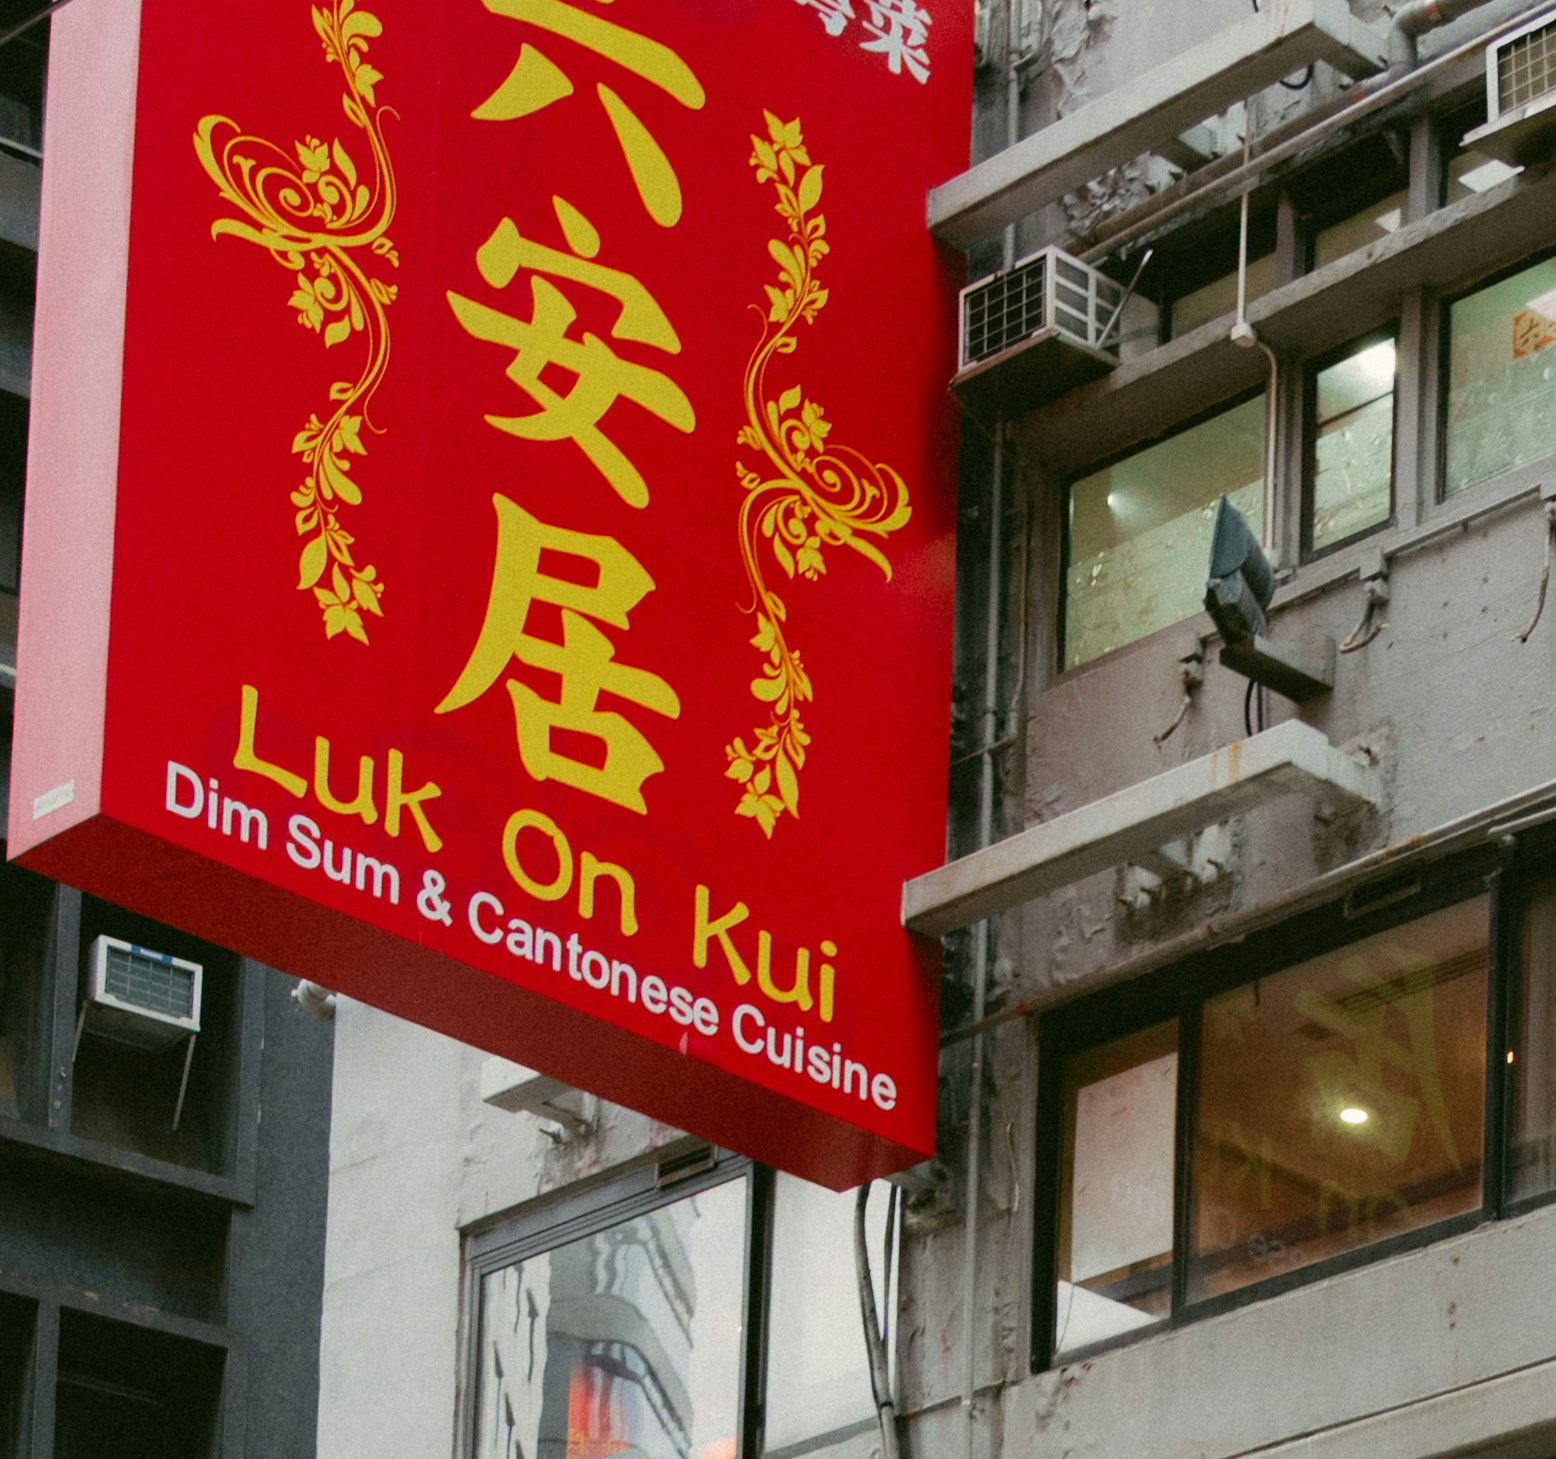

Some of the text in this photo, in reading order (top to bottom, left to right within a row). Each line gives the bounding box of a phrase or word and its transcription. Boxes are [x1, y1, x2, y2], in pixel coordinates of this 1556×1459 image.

[434, 0, 706, 814] 六安居
[165, 761, 898, 1111] Dim Sum & Cantonese Cuisine
[233, 685, 838, 1022] Luk On Kui
